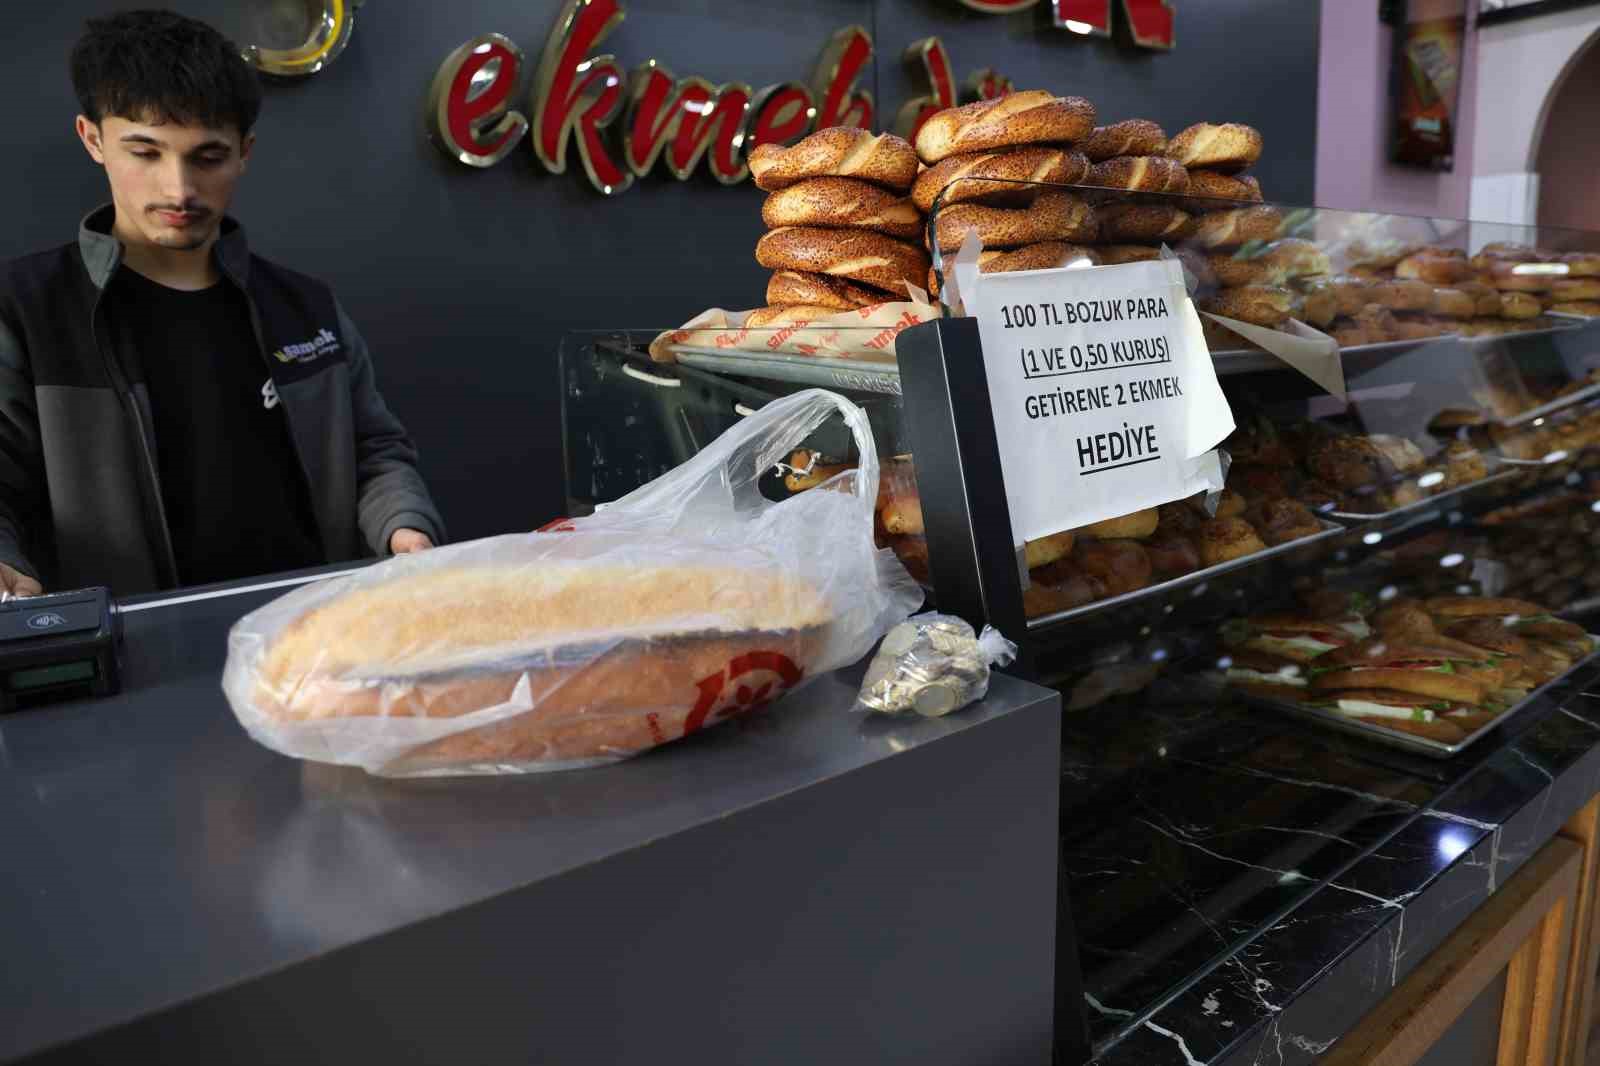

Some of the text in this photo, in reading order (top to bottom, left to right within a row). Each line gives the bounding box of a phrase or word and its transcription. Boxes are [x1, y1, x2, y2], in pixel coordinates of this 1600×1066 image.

[1001, 297, 1169, 328] 100 TL BOZUK PARA
[1021, 335, 1171, 378] (1 VE 0,50 KURUŞ)
[1025, 376, 1184, 420] GETİRENE 2 EKMEK
[1076, 422, 1159, 468] HEDİYE
